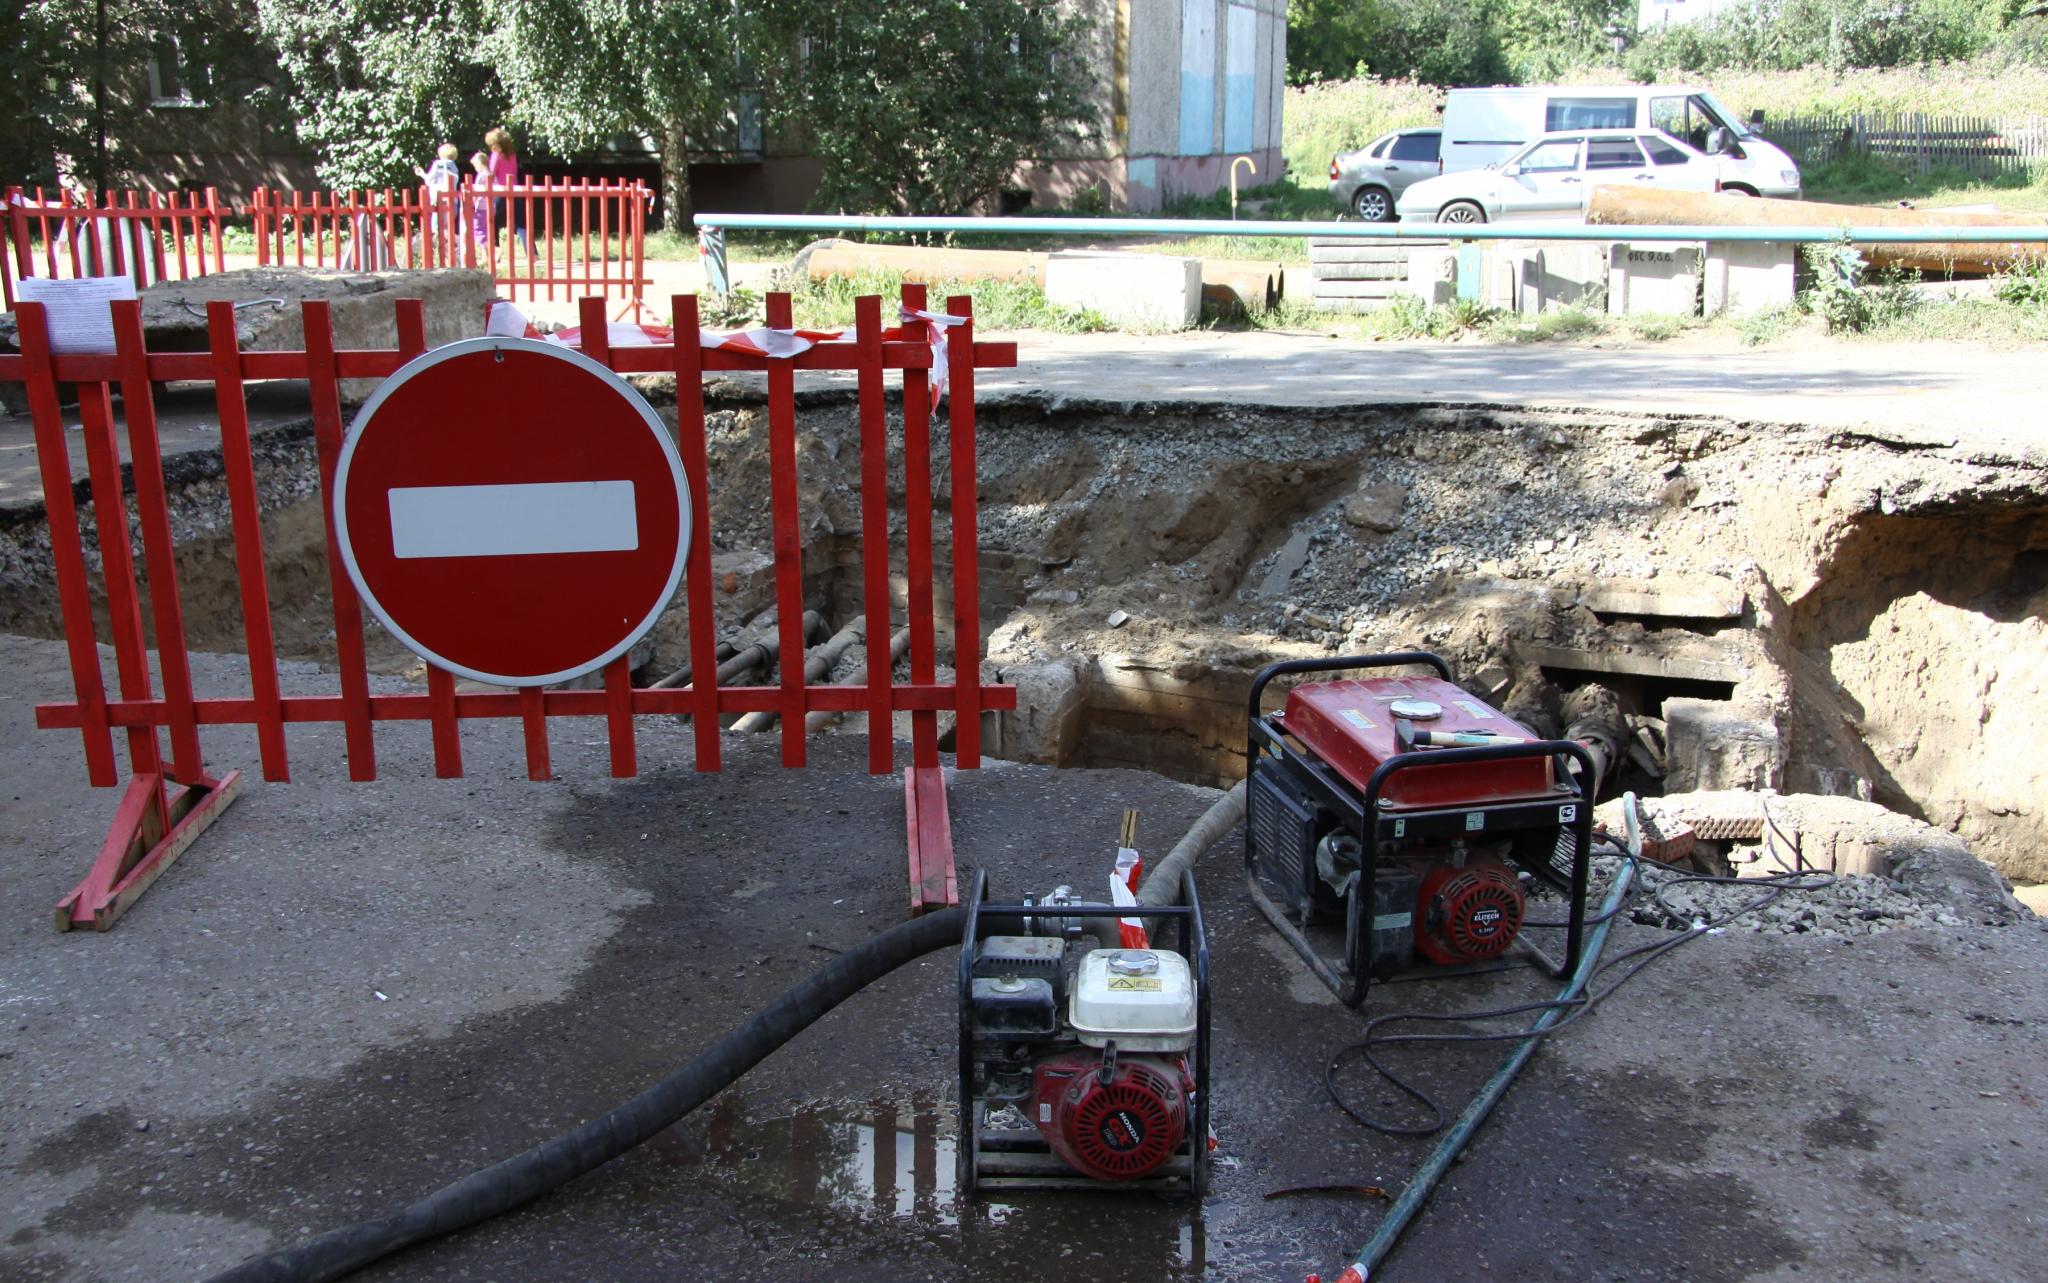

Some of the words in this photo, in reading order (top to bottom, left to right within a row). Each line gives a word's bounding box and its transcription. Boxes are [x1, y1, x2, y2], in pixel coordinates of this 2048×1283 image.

[1474, 913, 1500, 921] ELITECH
[1108, 1117, 1134, 1146] GX
[1119, 1112, 1140, 1143] HONDA
